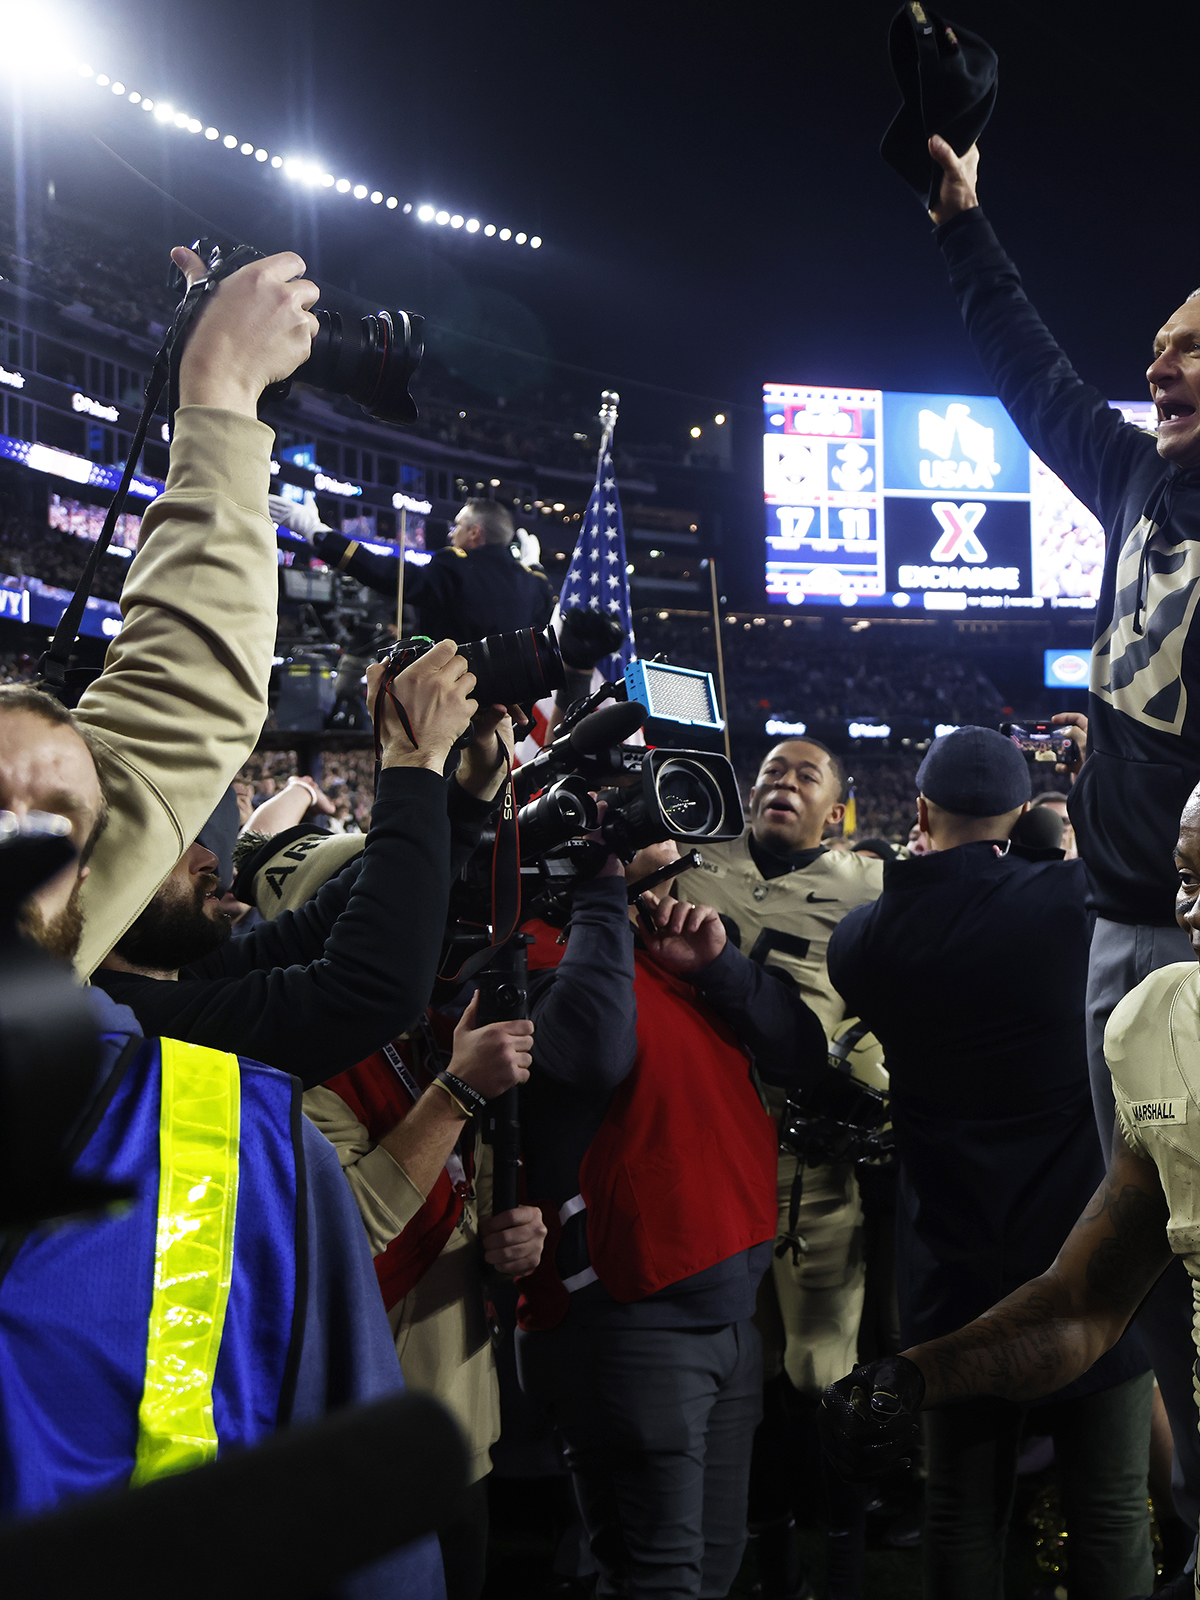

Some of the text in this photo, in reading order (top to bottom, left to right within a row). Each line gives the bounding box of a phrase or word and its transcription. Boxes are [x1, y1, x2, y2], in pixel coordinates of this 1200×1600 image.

[919, 459, 996, 489] USAA
[776, 506, 815, 538] 17
[838, 508, 870, 540] 11
[463, 1083, 480, 1100] LIVES
[1132, 1103, 1176, 1121] MARSHALL
